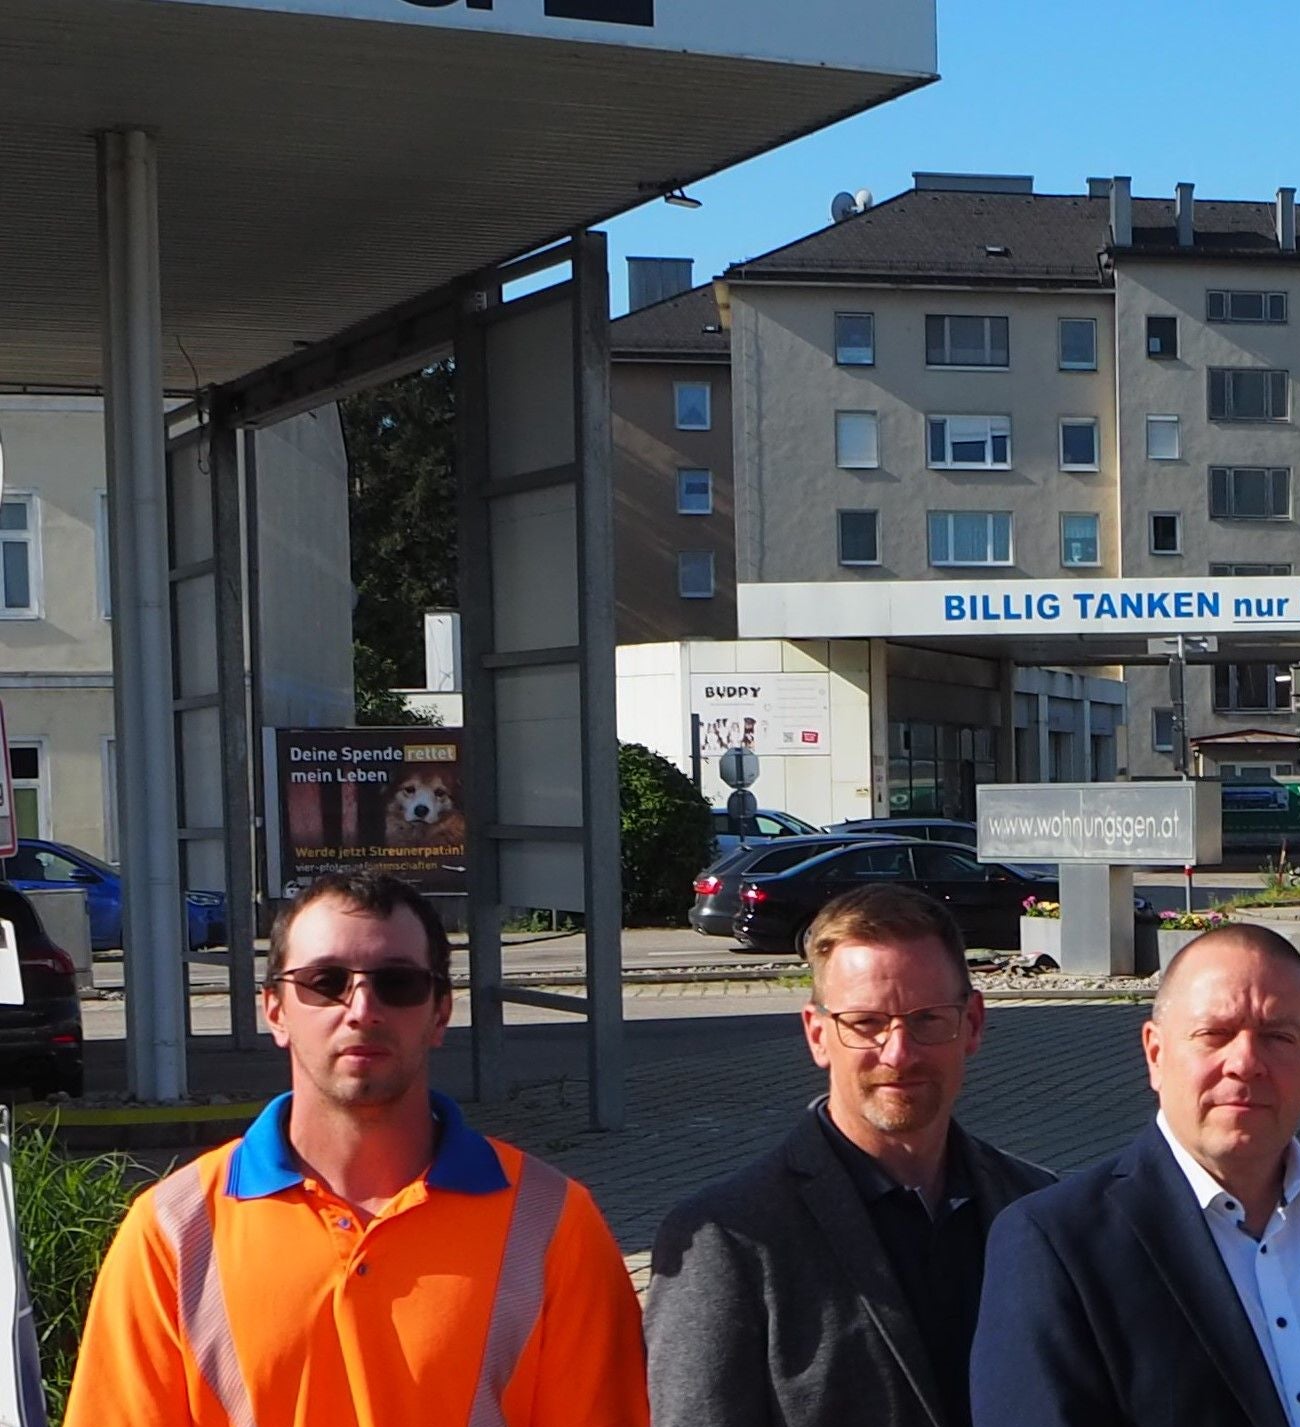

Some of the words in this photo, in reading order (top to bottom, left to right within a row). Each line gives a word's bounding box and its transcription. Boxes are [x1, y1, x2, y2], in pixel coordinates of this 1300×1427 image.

[945, 595, 1060, 620] BILLIG
[1073, 591, 1220, 619] TANKEN
[1234, 597, 1290, 618] nur
[290, 746, 338, 761] Deine
[342, 746, 402, 763] Spende
[408, 747, 455, 759] rettet
[291, 768, 332, 782] mein
[337, 768, 388, 782] Leben
[989, 810, 1179, 845] www.wohnungsgen.at
[295, 847, 335, 858] Werde
